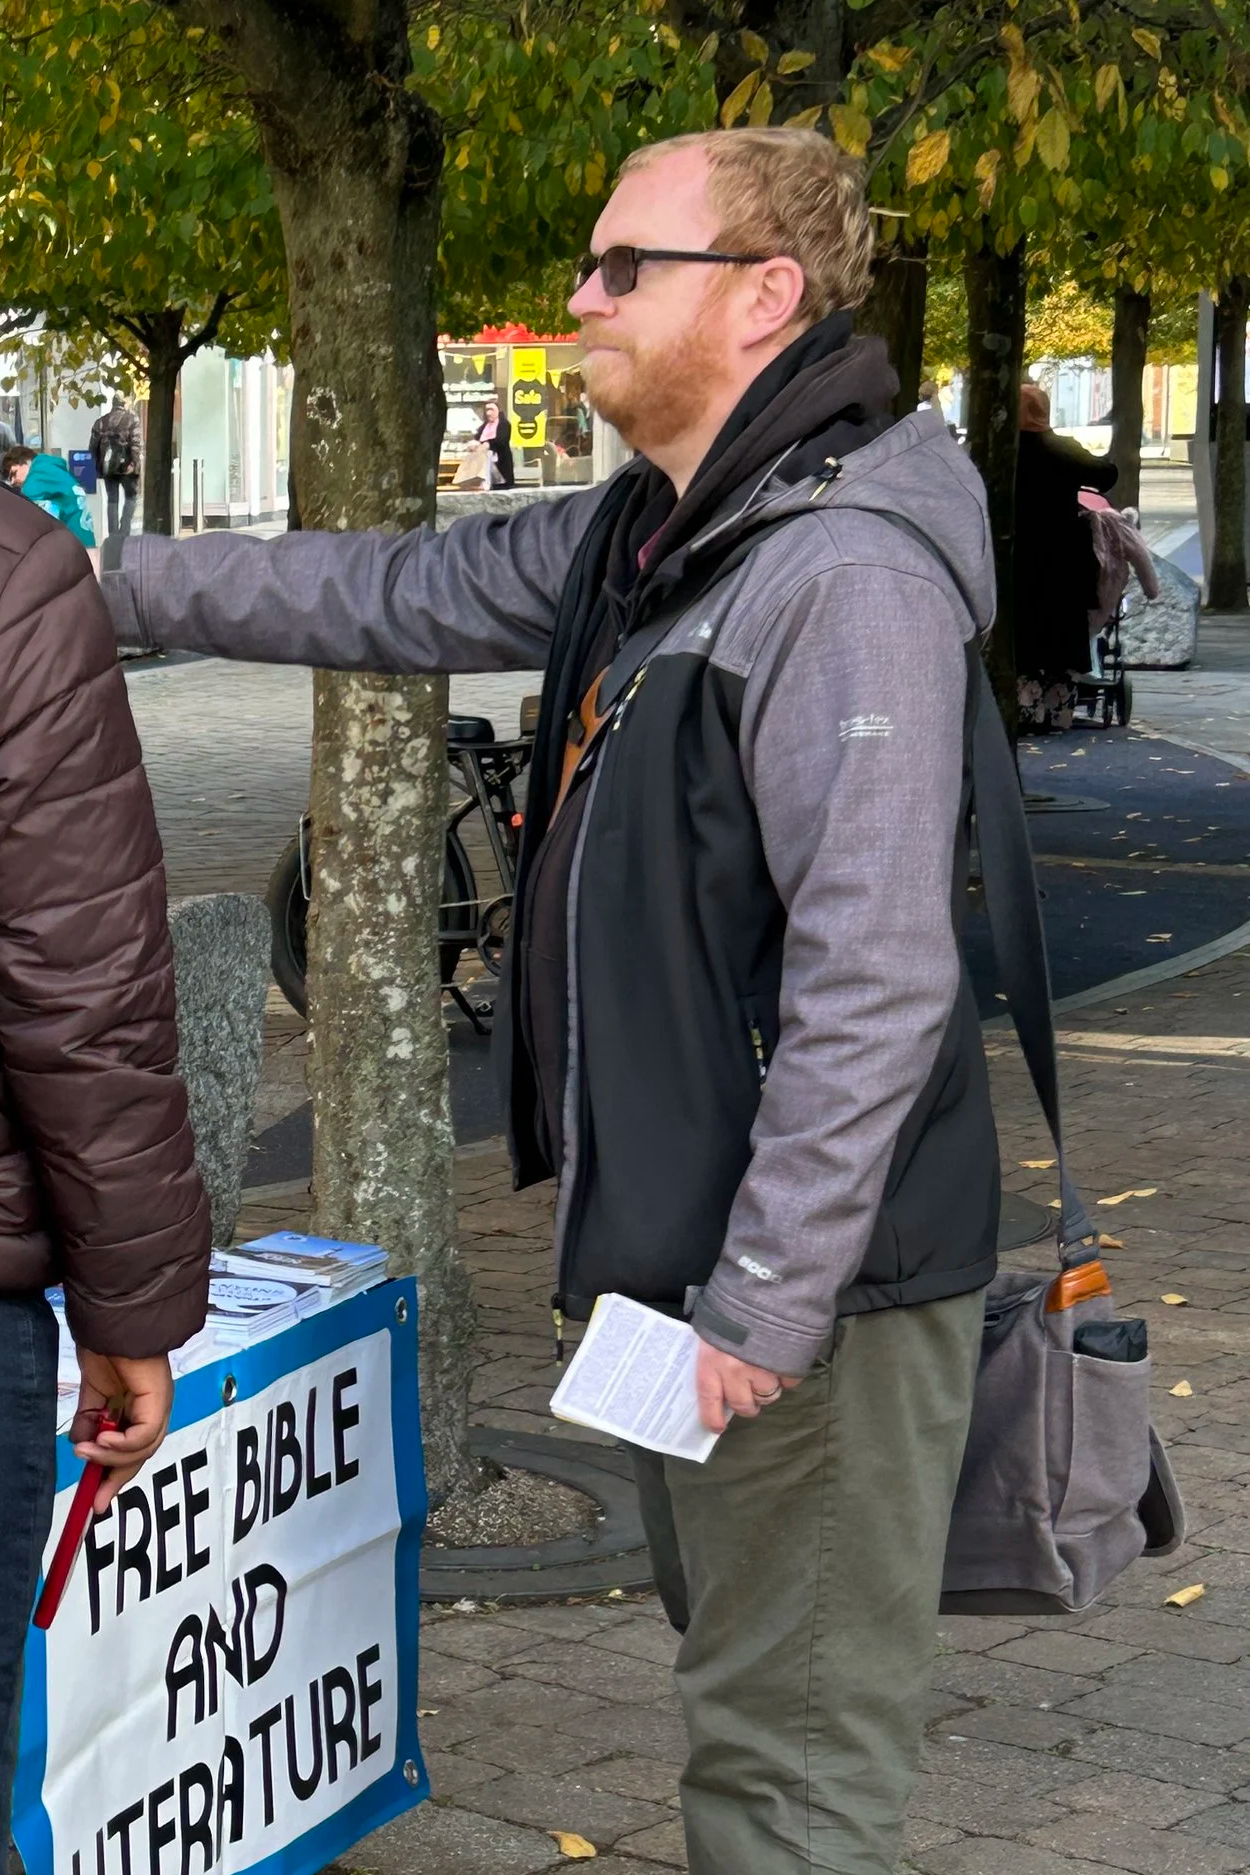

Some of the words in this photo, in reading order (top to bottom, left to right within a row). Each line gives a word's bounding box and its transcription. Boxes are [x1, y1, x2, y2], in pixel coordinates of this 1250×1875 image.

[84, 1448, 211, 1636] FREE
[233, 1367, 361, 1545] BIBLE
[71, 1643, 382, 1875] TERATURE
[165, 1563, 288, 1742] AND
